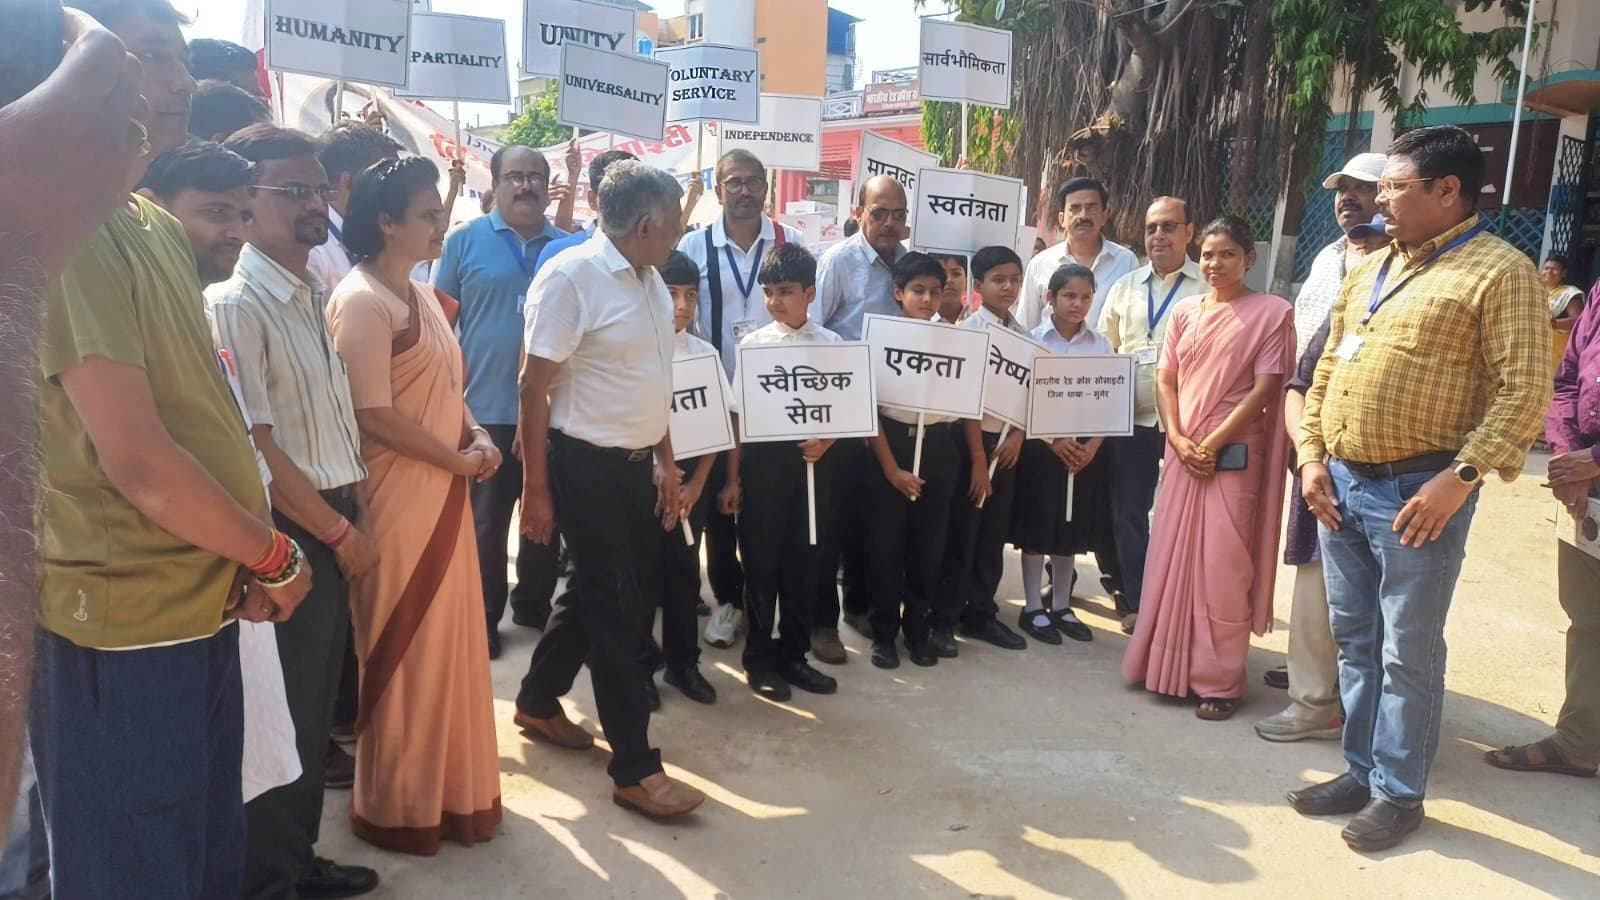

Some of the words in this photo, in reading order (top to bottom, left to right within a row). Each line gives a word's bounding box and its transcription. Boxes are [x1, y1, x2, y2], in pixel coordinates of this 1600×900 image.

[275, 15, 404, 52] HUMANITY
[540, 23, 625, 51] UNITY
[410, 51, 502, 68] PARTIALITY
[922, 49, 1006, 76] सार्वभौमिकता
[669, 66, 755, 83] OLUNTARY
[566, 74, 663, 106] UNIVERSALITY
[672, 85, 737, 101] SERVICE
[725, 130, 814, 143] INDEPENDENCE
[927, 193, 1008, 223] स्वतंत्रता
[884, 346, 966, 379] एकता
[757, 365, 853, 393] स्वैच्छिक
[1036, 376, 1060, 385] भारतीय
[1063, 375, 1073, 385] रेड
[785, 398, 832, 424] सेवा
